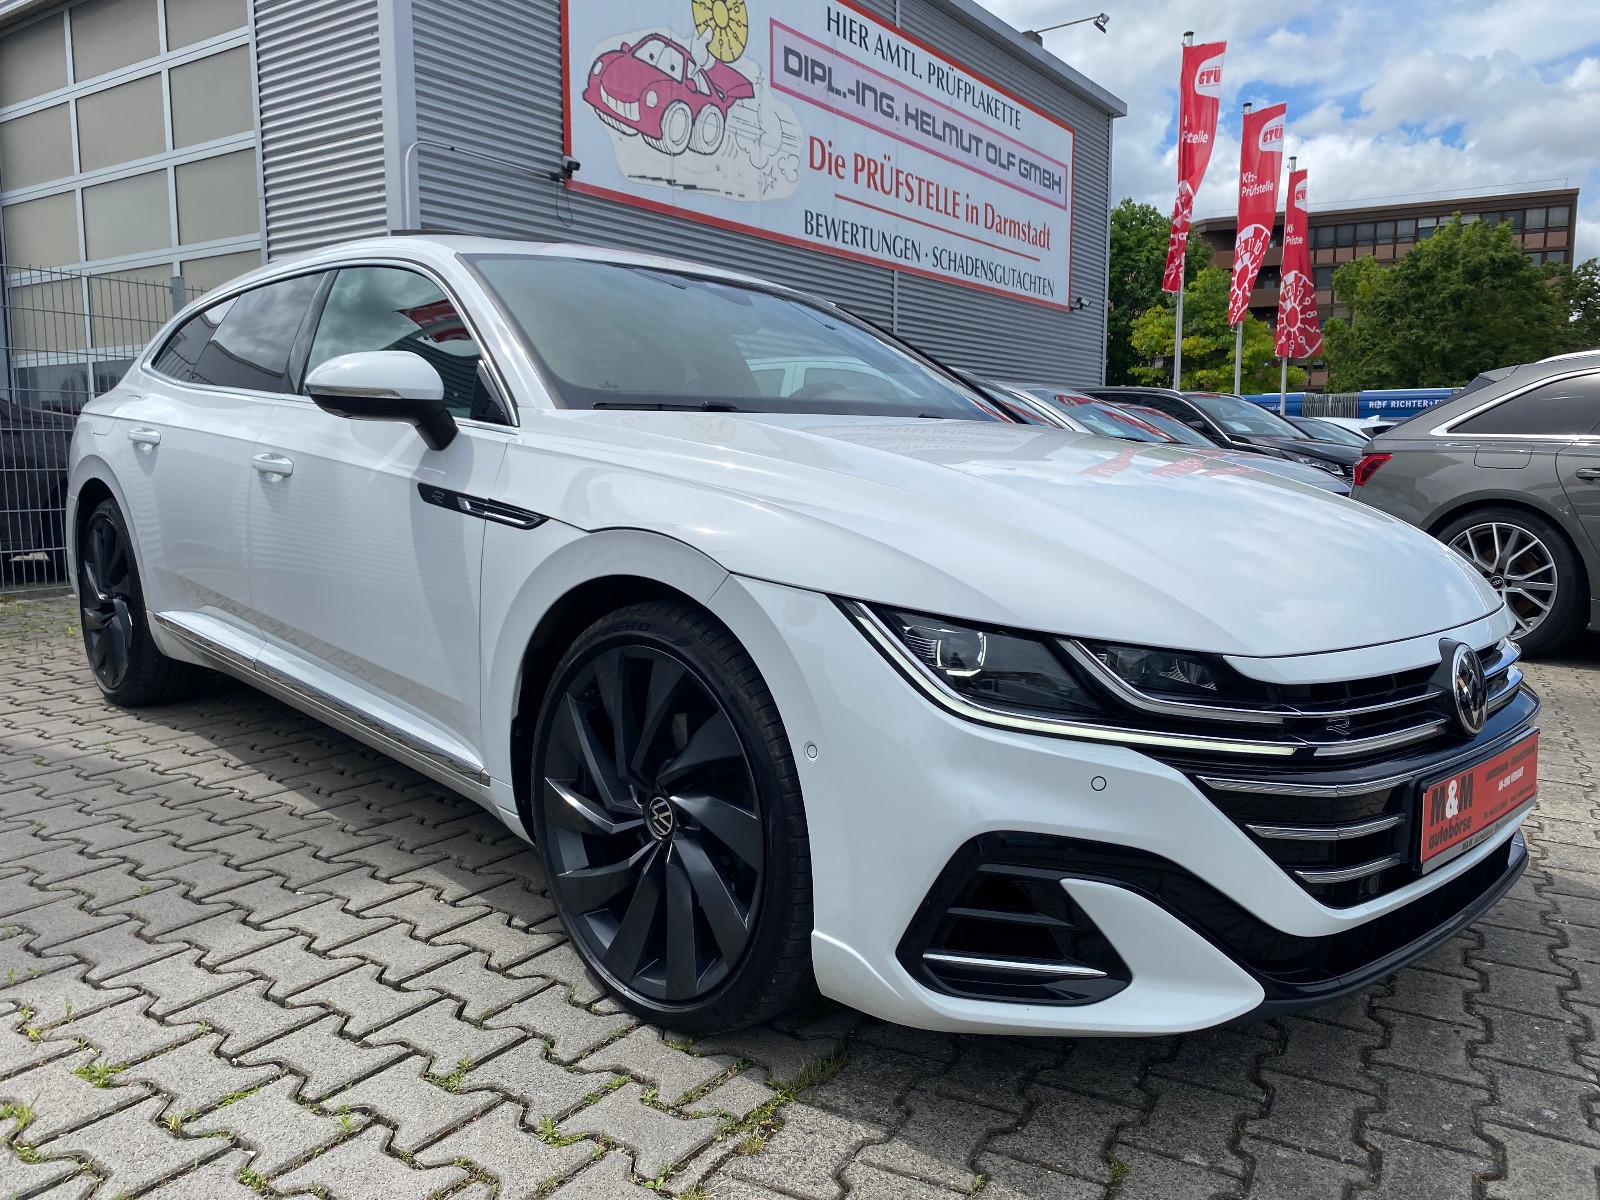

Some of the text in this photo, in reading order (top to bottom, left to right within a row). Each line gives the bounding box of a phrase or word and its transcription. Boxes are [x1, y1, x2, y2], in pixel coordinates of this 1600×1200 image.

[826, 6, 1022, 131] HIER AMTL. PRÜFPLAKETTE
[783, 45, 1062, 194] DIPL.-ING. HELMUT OLF GMBH
[809, 135, 1051, 251] Die PRÜFSTELLE in Darmstadt
[1241, 181, 1274, 198] Prüfstelle
[804, 209, 1055, 298] BEWERTUNGEN SCHADENSGUTACHTEN
[1428, 815, 1472, 850] autobörse
[1430, 771, 1473, 828] M&M
